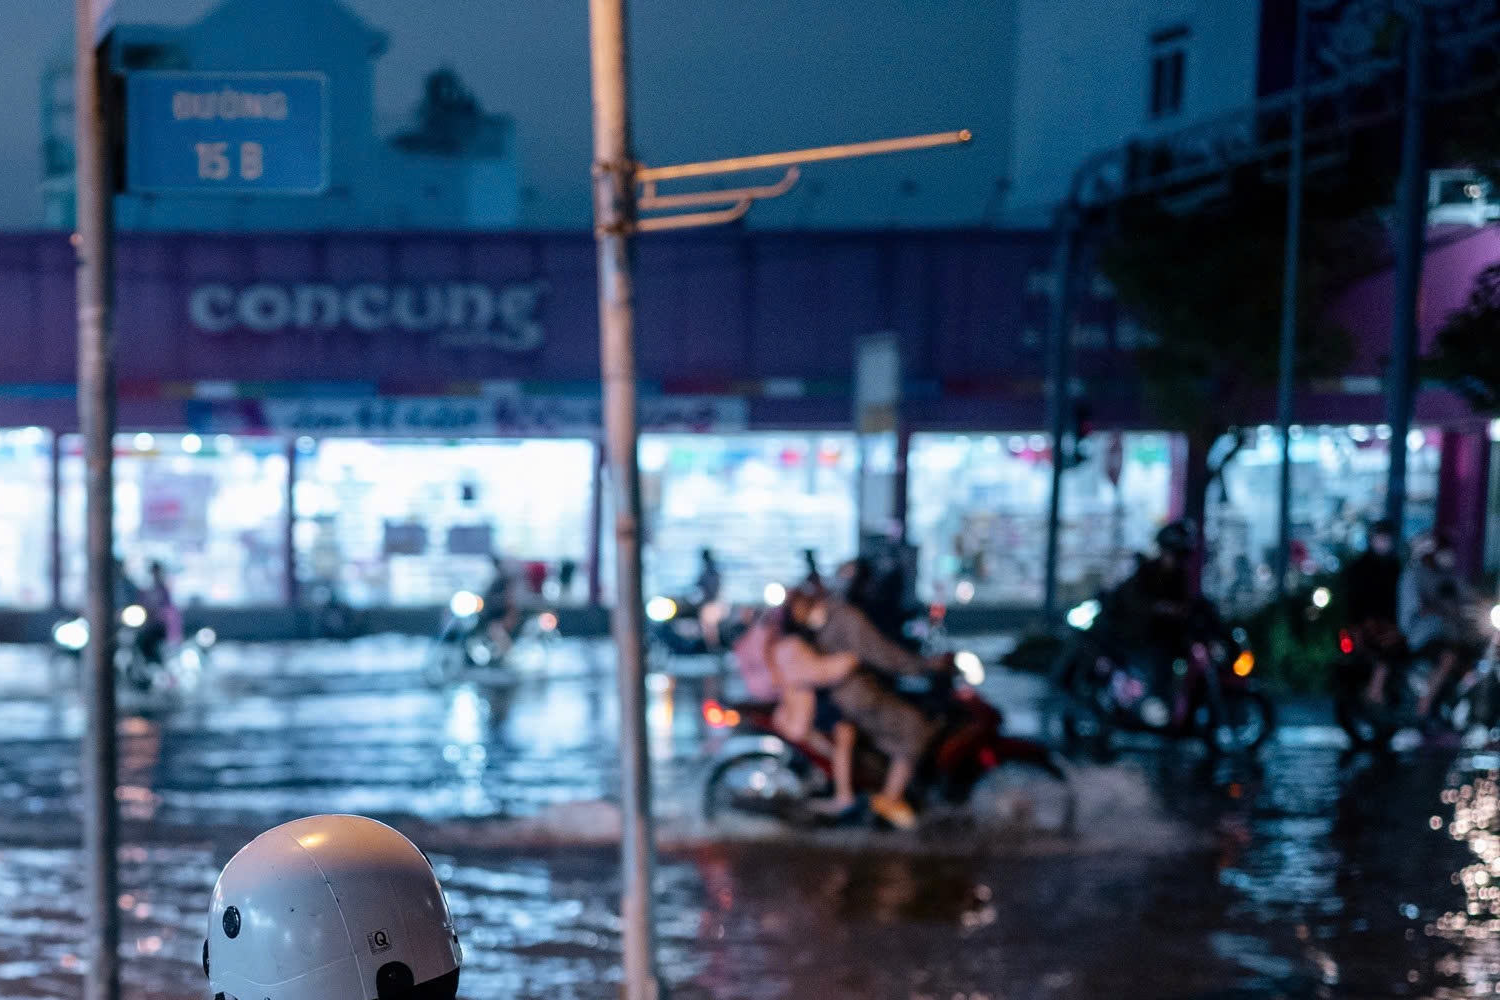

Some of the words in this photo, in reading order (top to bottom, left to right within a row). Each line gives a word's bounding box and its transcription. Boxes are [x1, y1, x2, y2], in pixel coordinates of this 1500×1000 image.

[195, 141, 229, 180] 15
[189, 280, 550, 352] concung
[375, 931, 388, 946] Q
